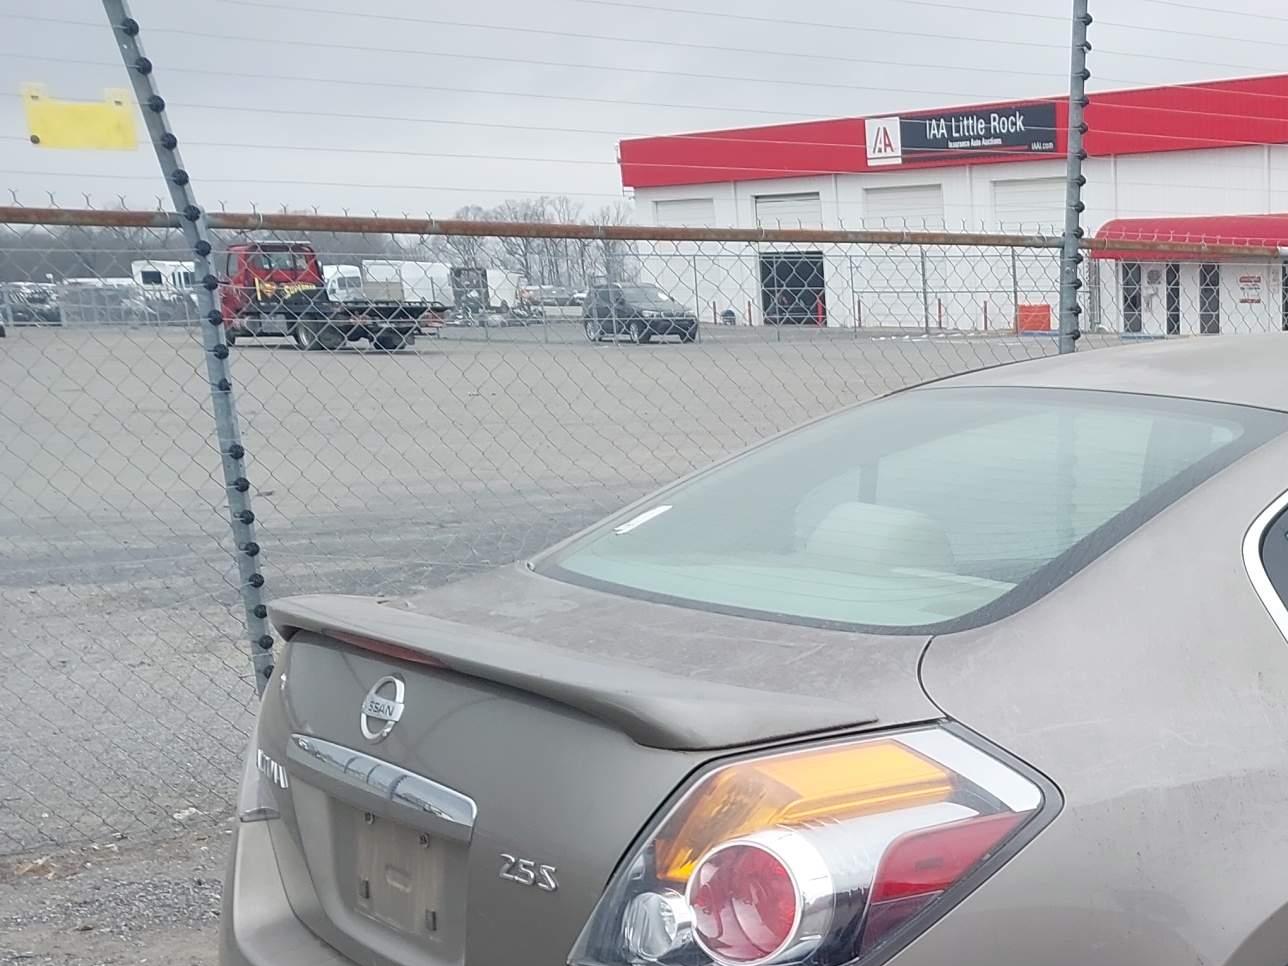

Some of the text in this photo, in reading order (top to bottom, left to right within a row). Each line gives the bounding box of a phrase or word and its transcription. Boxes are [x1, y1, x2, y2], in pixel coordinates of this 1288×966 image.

[926, 110, 1025, 140] IAA Little Rock
